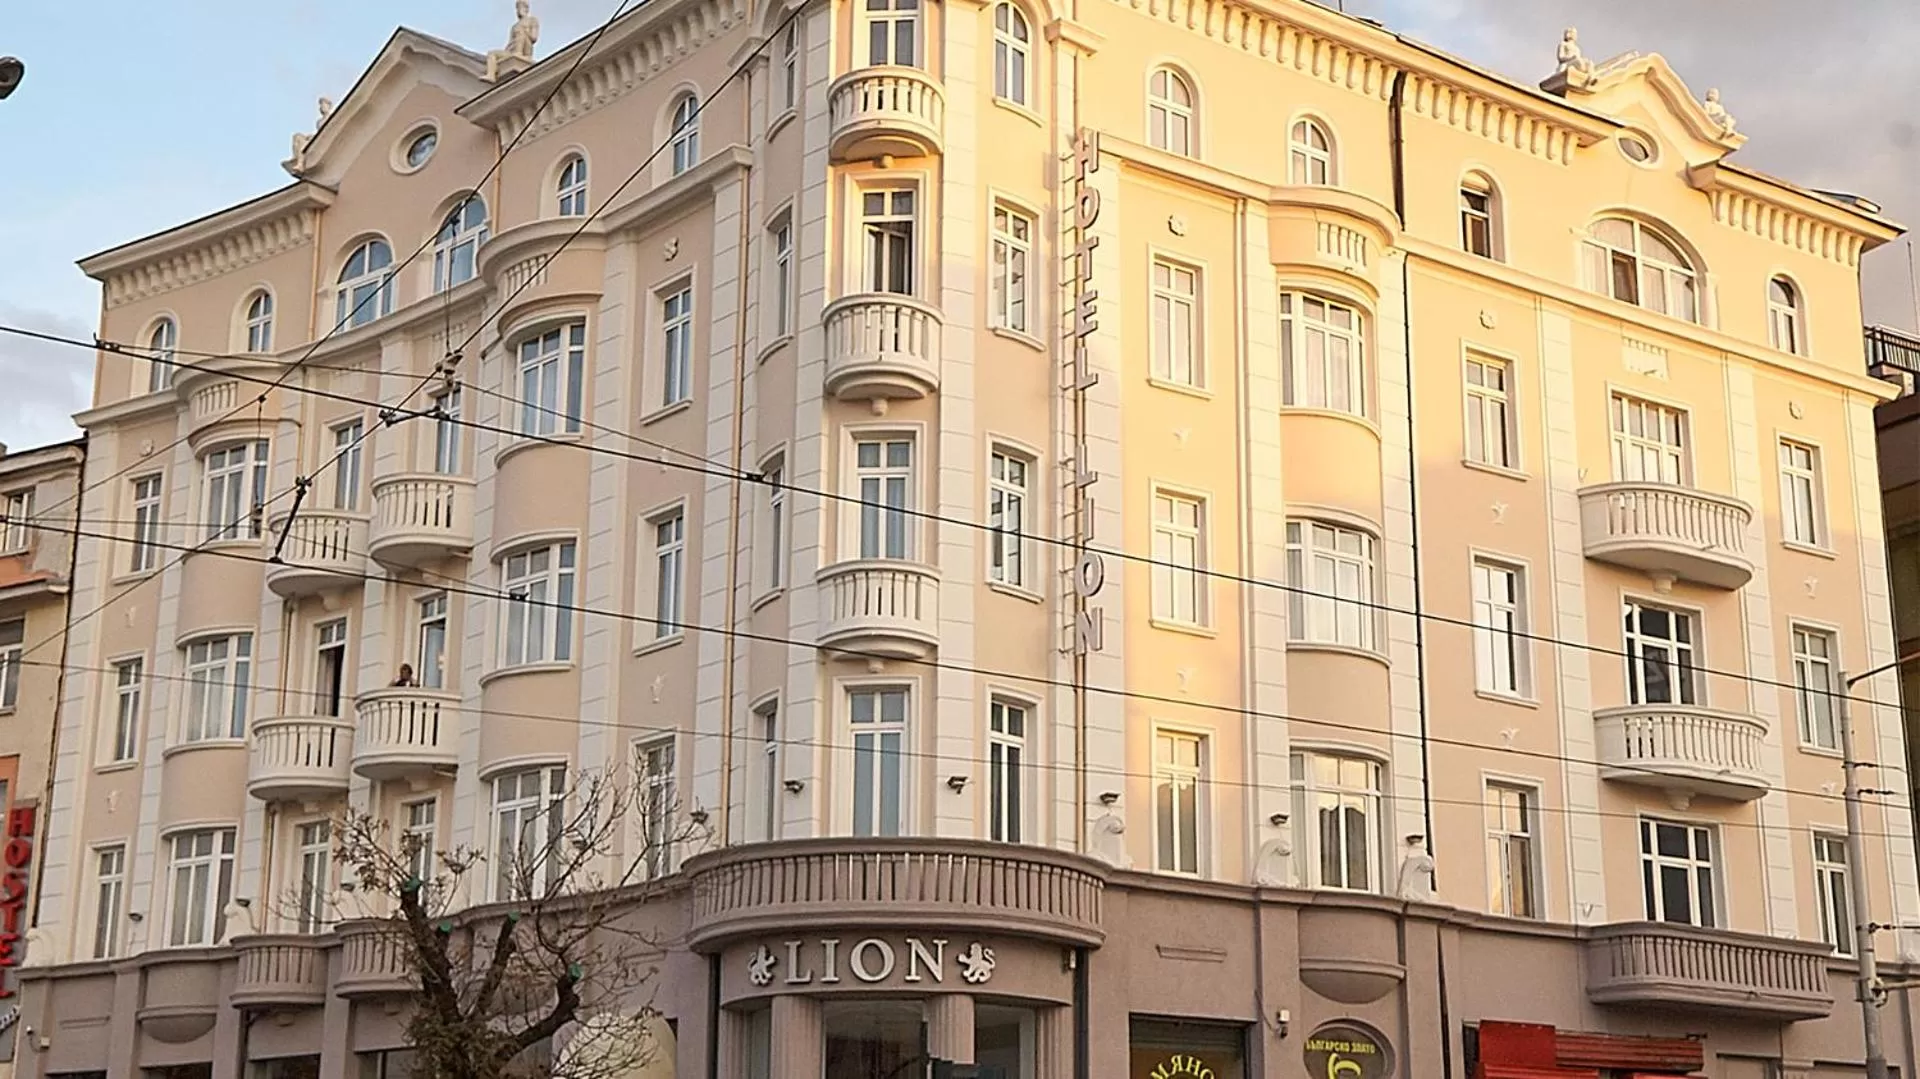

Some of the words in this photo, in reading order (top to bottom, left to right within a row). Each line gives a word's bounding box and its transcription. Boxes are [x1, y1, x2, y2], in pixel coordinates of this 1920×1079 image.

[1074, 127, 1100, 391] HOTEL
[1074, 444, 1104, 655] LION
[0, 807, 34, 997] HOSTEL
[784, 938, 948, 983] LION
